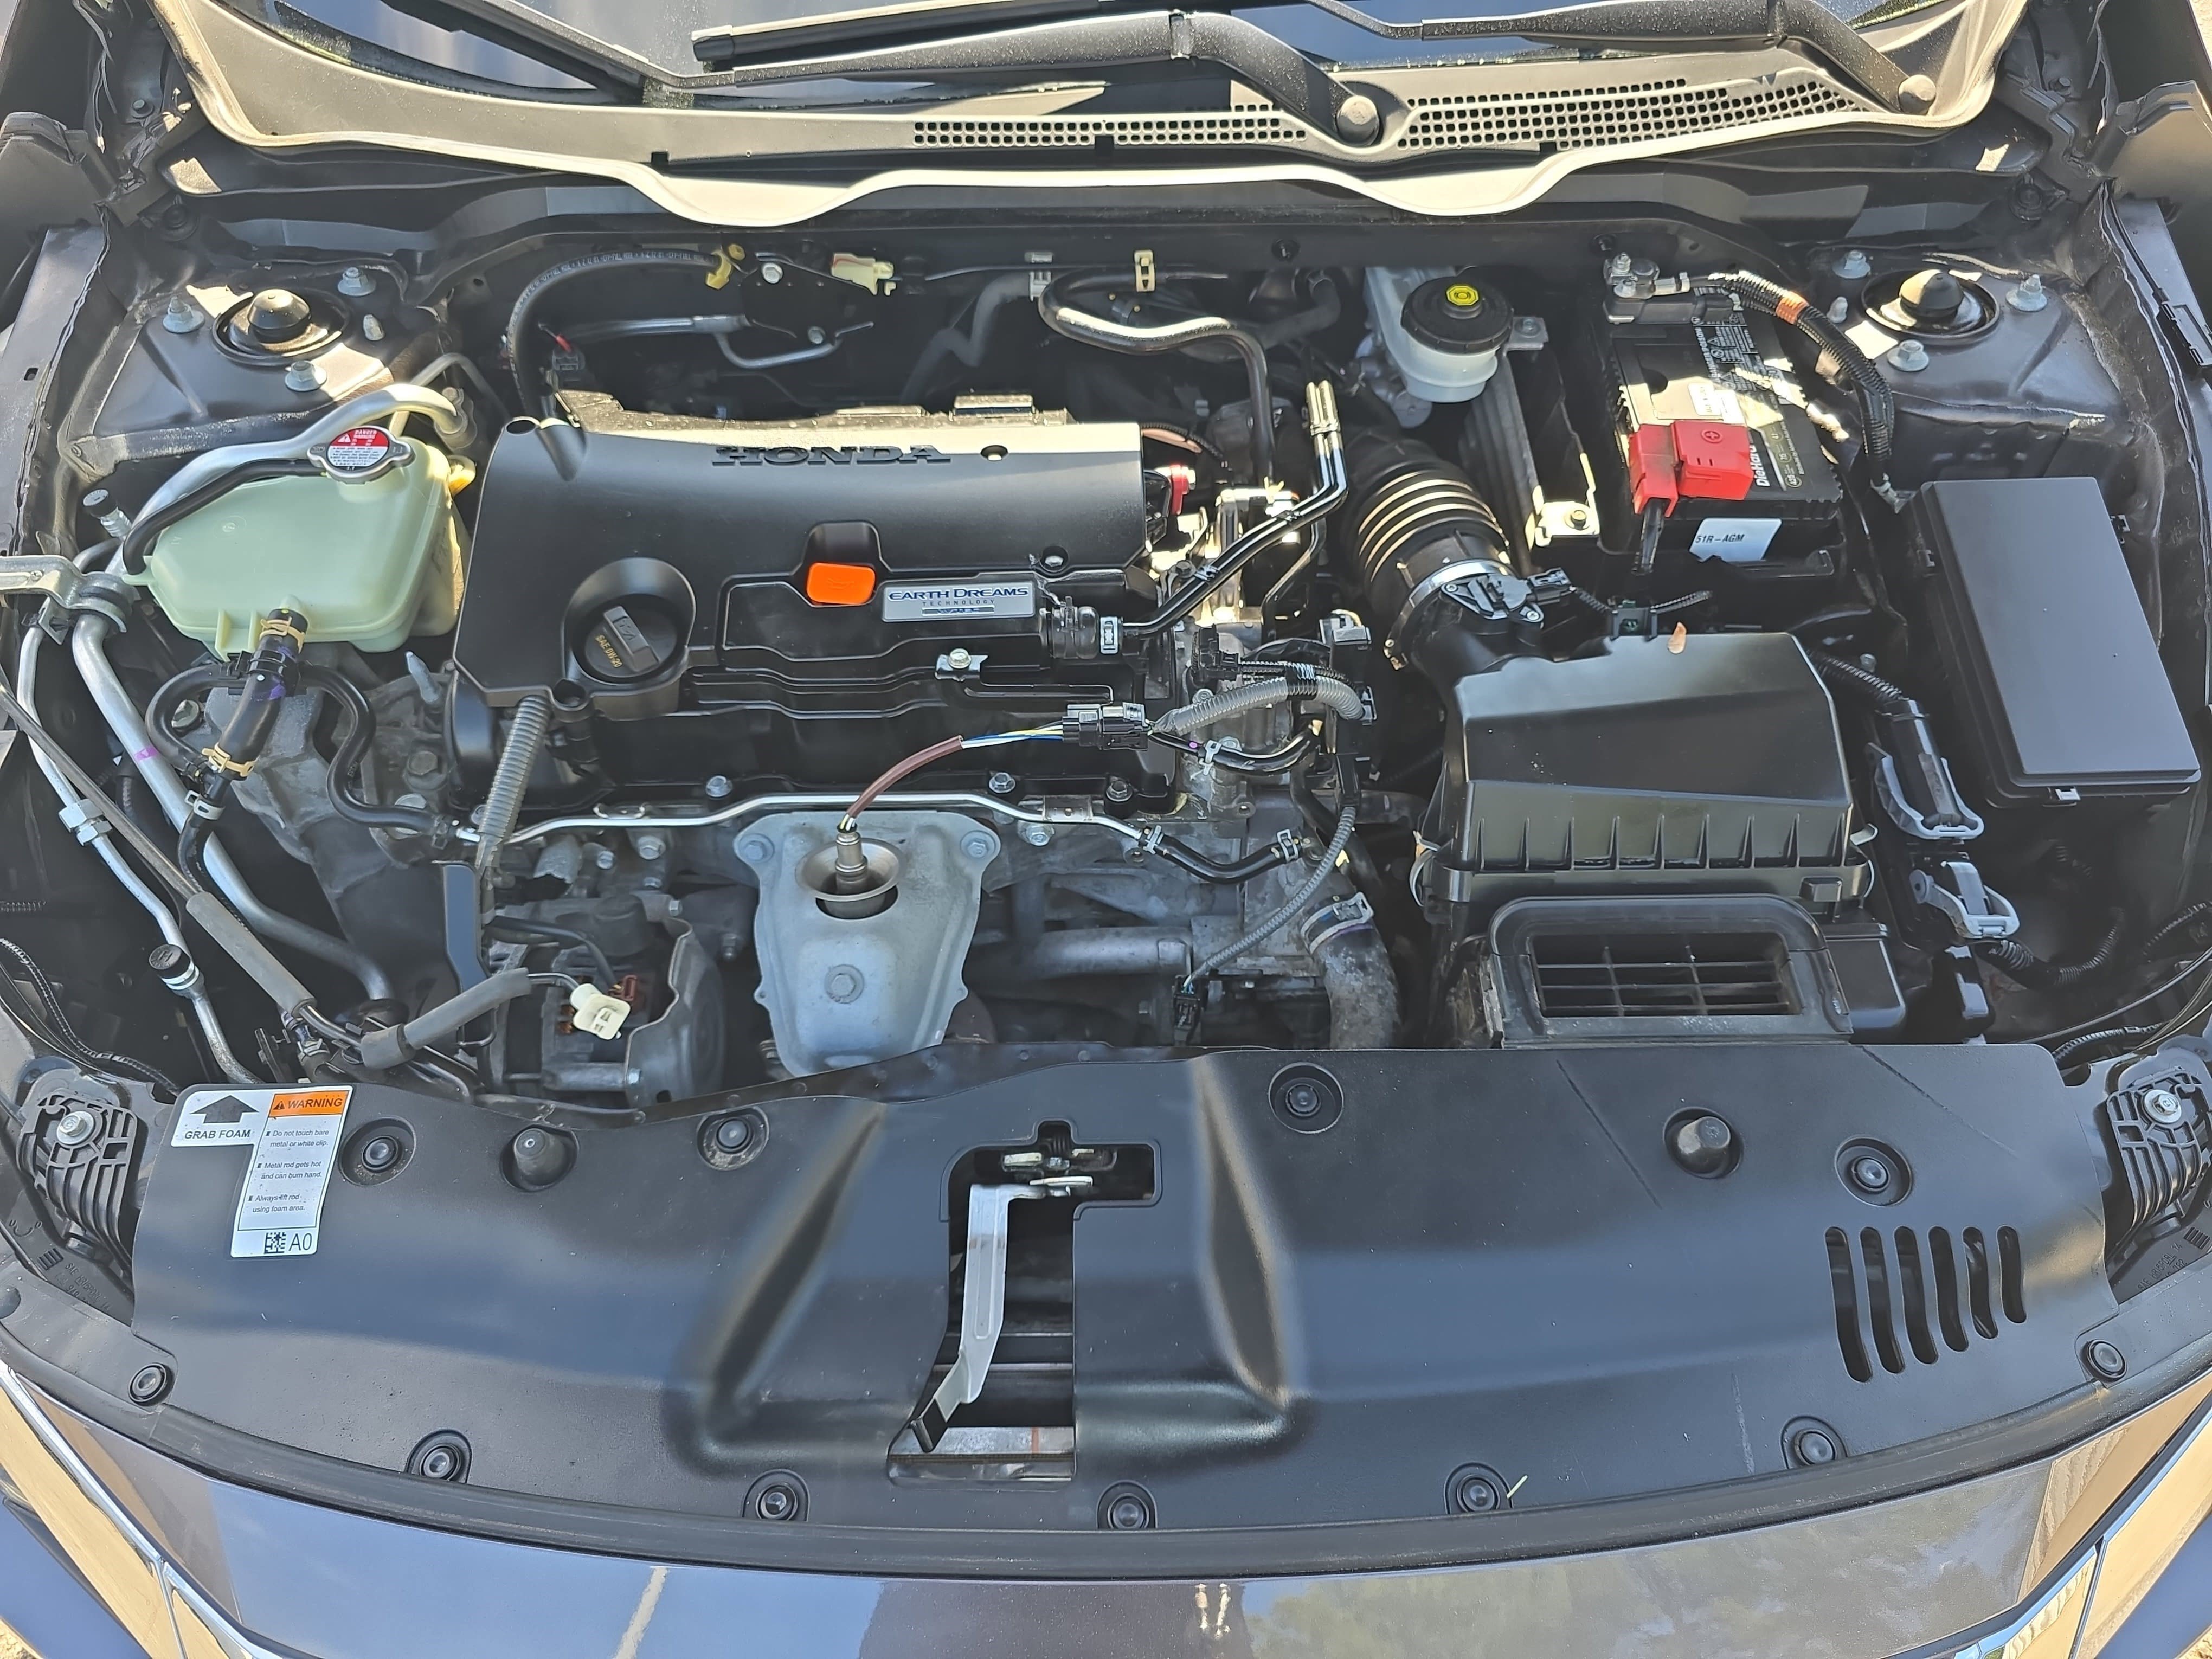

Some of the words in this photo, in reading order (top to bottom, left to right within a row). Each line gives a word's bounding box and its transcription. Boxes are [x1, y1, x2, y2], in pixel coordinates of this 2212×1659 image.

[712, 445, 951, 466] HONDA
[889, 590, 949, 601] EARTH
[954, 587, 1028, 597] DREAMS
[595, 635, 611, 649] SAE
[605, 648, 622, 667] 0W-20
[288, 1098, 343, 1109] WARNING
[184, 1130, 216, 1139] GRAB
[218, 1129, 251, 1138] FOAM
[314, 1140, 329, 1148] clip.
[255, 1194, 278, 1203] Always
[288, 1233, 312, 1251] A0
[65, 1262, 79, 1275] SAE
